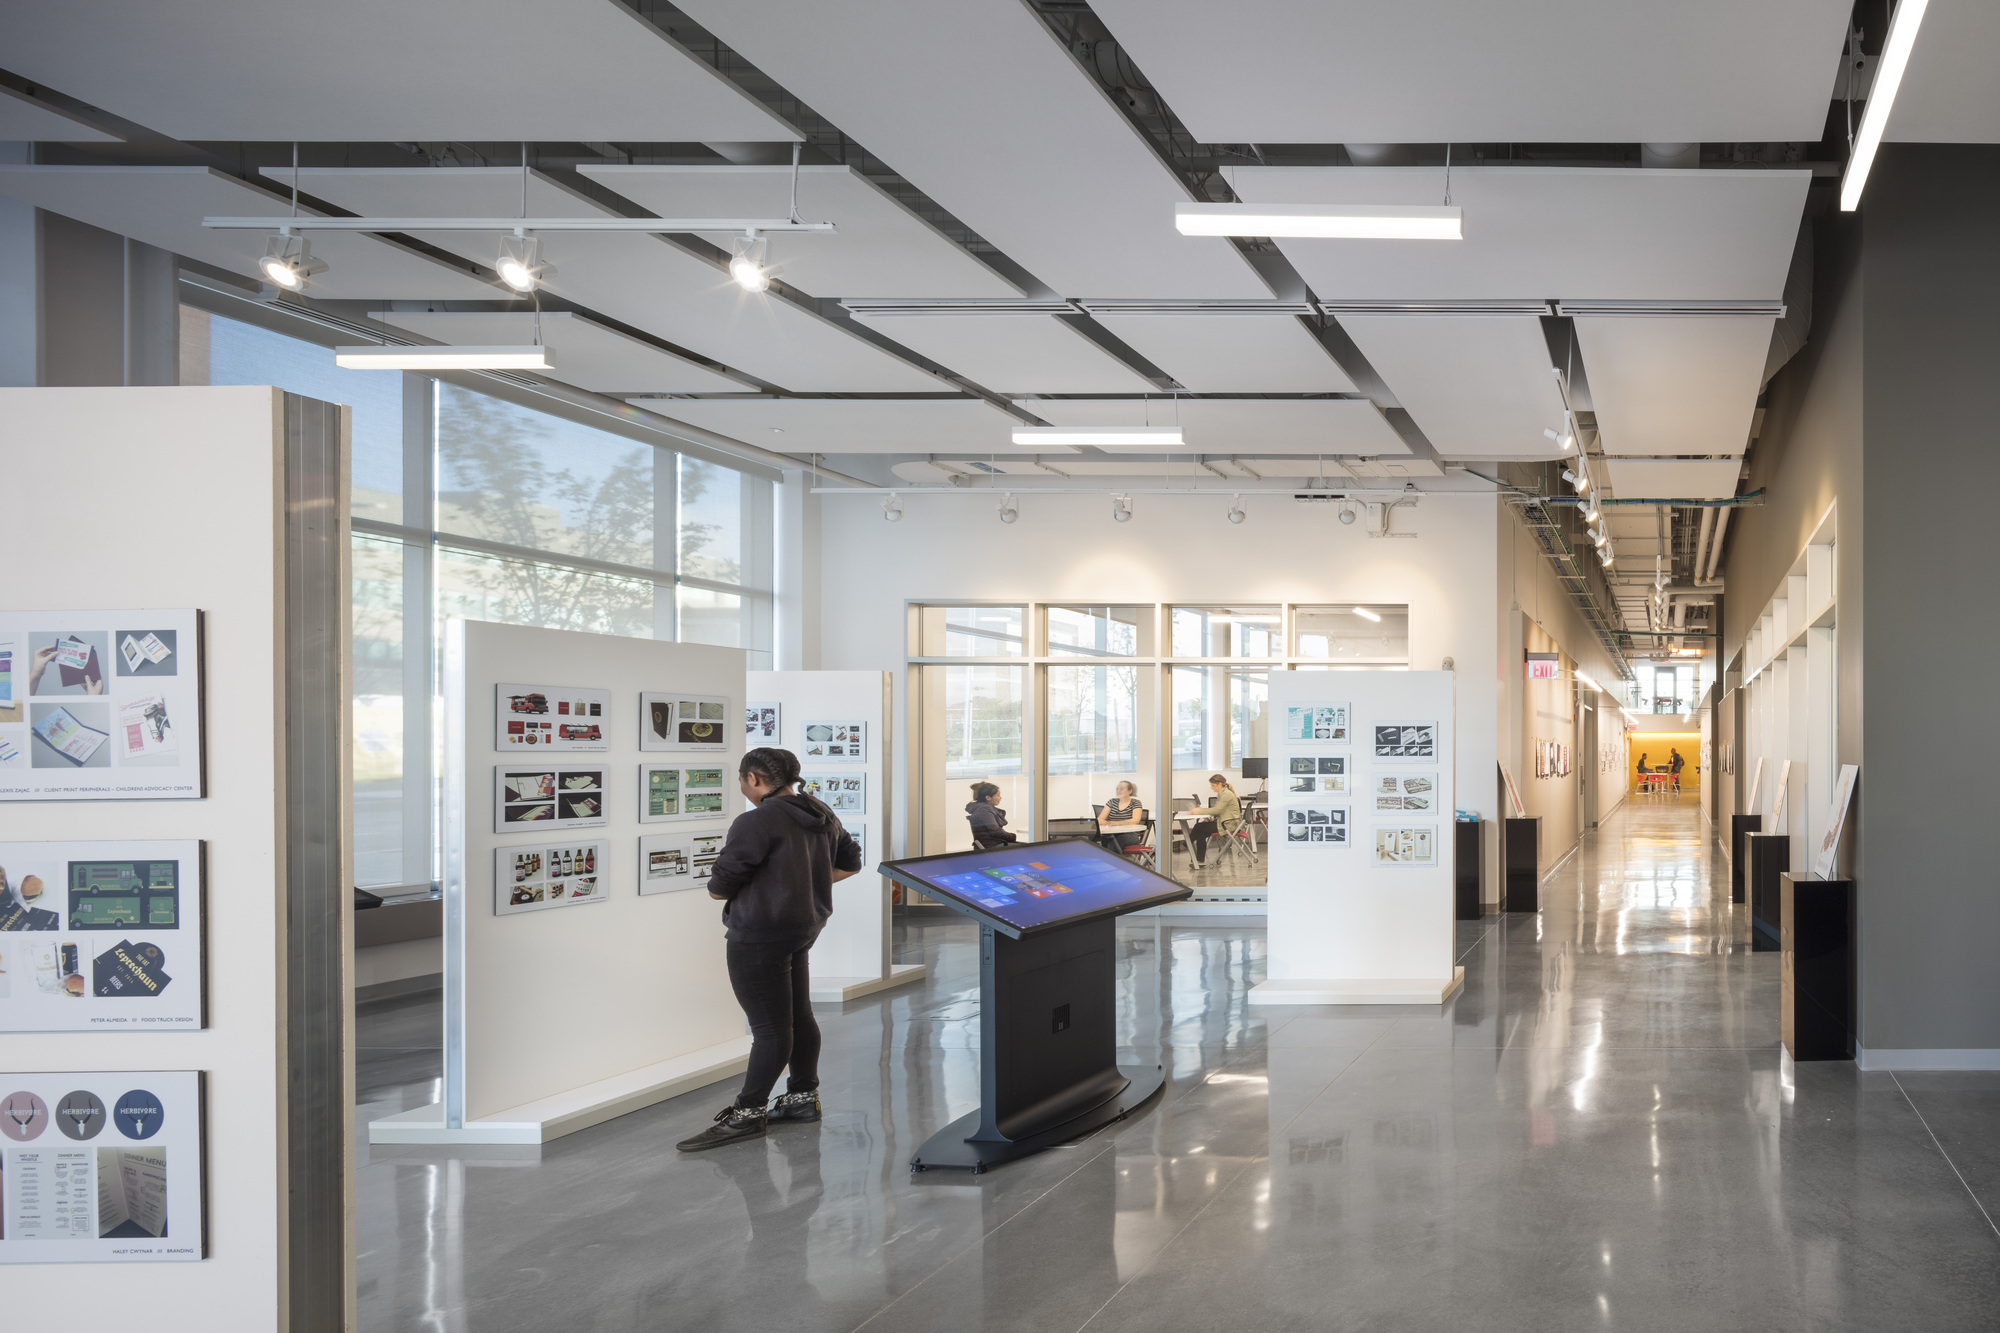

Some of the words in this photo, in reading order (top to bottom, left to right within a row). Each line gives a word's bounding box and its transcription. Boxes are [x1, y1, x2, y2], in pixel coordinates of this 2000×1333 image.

[1533, 662, 1553, 678] EXIT
[115, 948, 158, 991] Leprechaun
[109, 975, 124, 990] BEERS
[120, 1107, 158, 1115] HERBIVORE
[123, 1152, 144, 1162] DINNER
[145, 1157, 166, 1167] MENU
